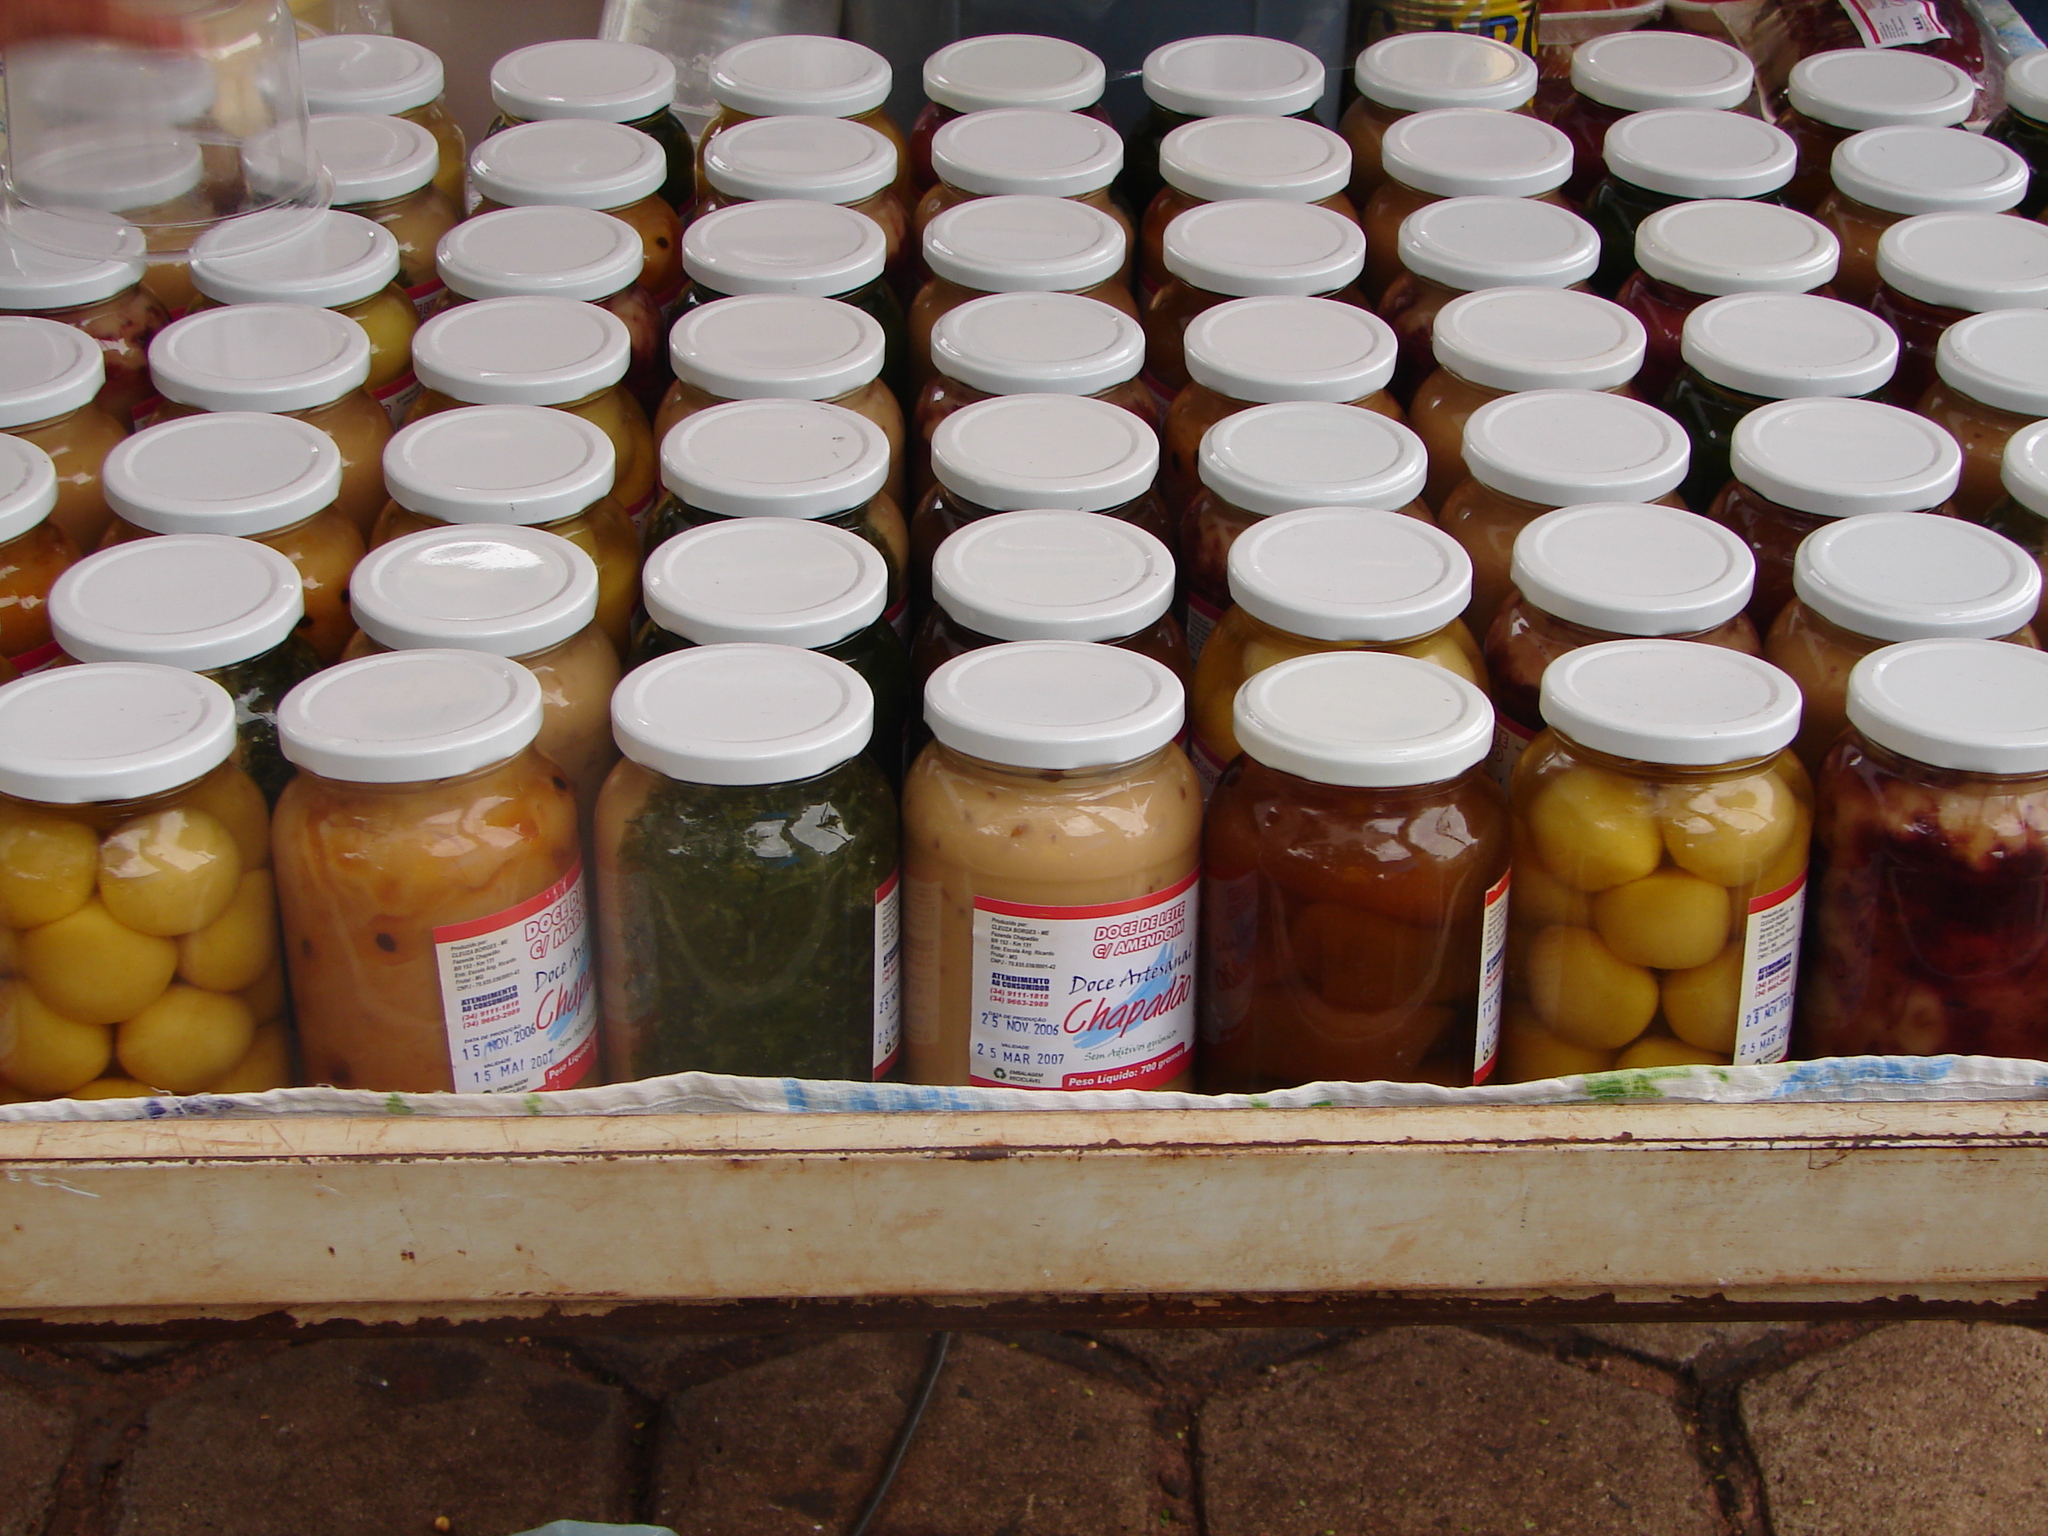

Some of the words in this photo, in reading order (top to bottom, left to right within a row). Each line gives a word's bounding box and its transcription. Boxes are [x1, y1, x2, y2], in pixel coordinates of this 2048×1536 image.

[524, 899, 569, 942] DOCE
[1094, 920, 1138, 941] DOCE
[1139, 914, 1158, 933] DE
[1158, 900, 1186, 927] LEITE
[530, 934, 549, 960] C/
[1092, 943, 1113, 959] C/
[1113, 918, 1185, 956] AMENDOIM
[535, 962, 567, 993] Doce
[992, 972, 1050, 984] ATENDIMENTO
[1068, 975, 1115, 995] Doce
[1119, 940, 1193, 988] Artesanal
[461, 984, 517, 1006] ATENDIMENTO
[990, 987, 1005, 996] (34)
[1007, 991, 1049, 1000] 9111-1818
[1002, 981, 1049, 991] CONSUMIDOR
[462, 1005, 472, 1013] AO
[473, 991, 518, 1010] CONSUMIDOR
[989, 995, 1005, 1003] (34)
[1063, 974, 1192, 1038] Chapadão
[462, 1012, 478, 1022] (34)
[480, 1000, 519, 1017] 9111-1818
[463, 1020, 479, 1030] (34)
[514, 1022, 536, 1043] 2006
[1006, 1020, 1030, 1034] NOV.
[1034, 1023, 1060, 1036] 2006
[1001, 1042, 1030, 1050] VALIDADE
[1084, 1051, 1105, 1061] Sem
[500, 1058, 524, 1077] MAI
[531, 1048, 554, 1070] 2007
[1003, 1052, 1030, 1065] MAR
[1037, 1053, 1065, 1065] 2007
[549, 1064, 567, 1080] Peso
[1068, 1077, 1094, 1087] Peso
[1097, 1070, 1138, 1084] Líquido:
[1140, 1061, 1157, 1074] 700
